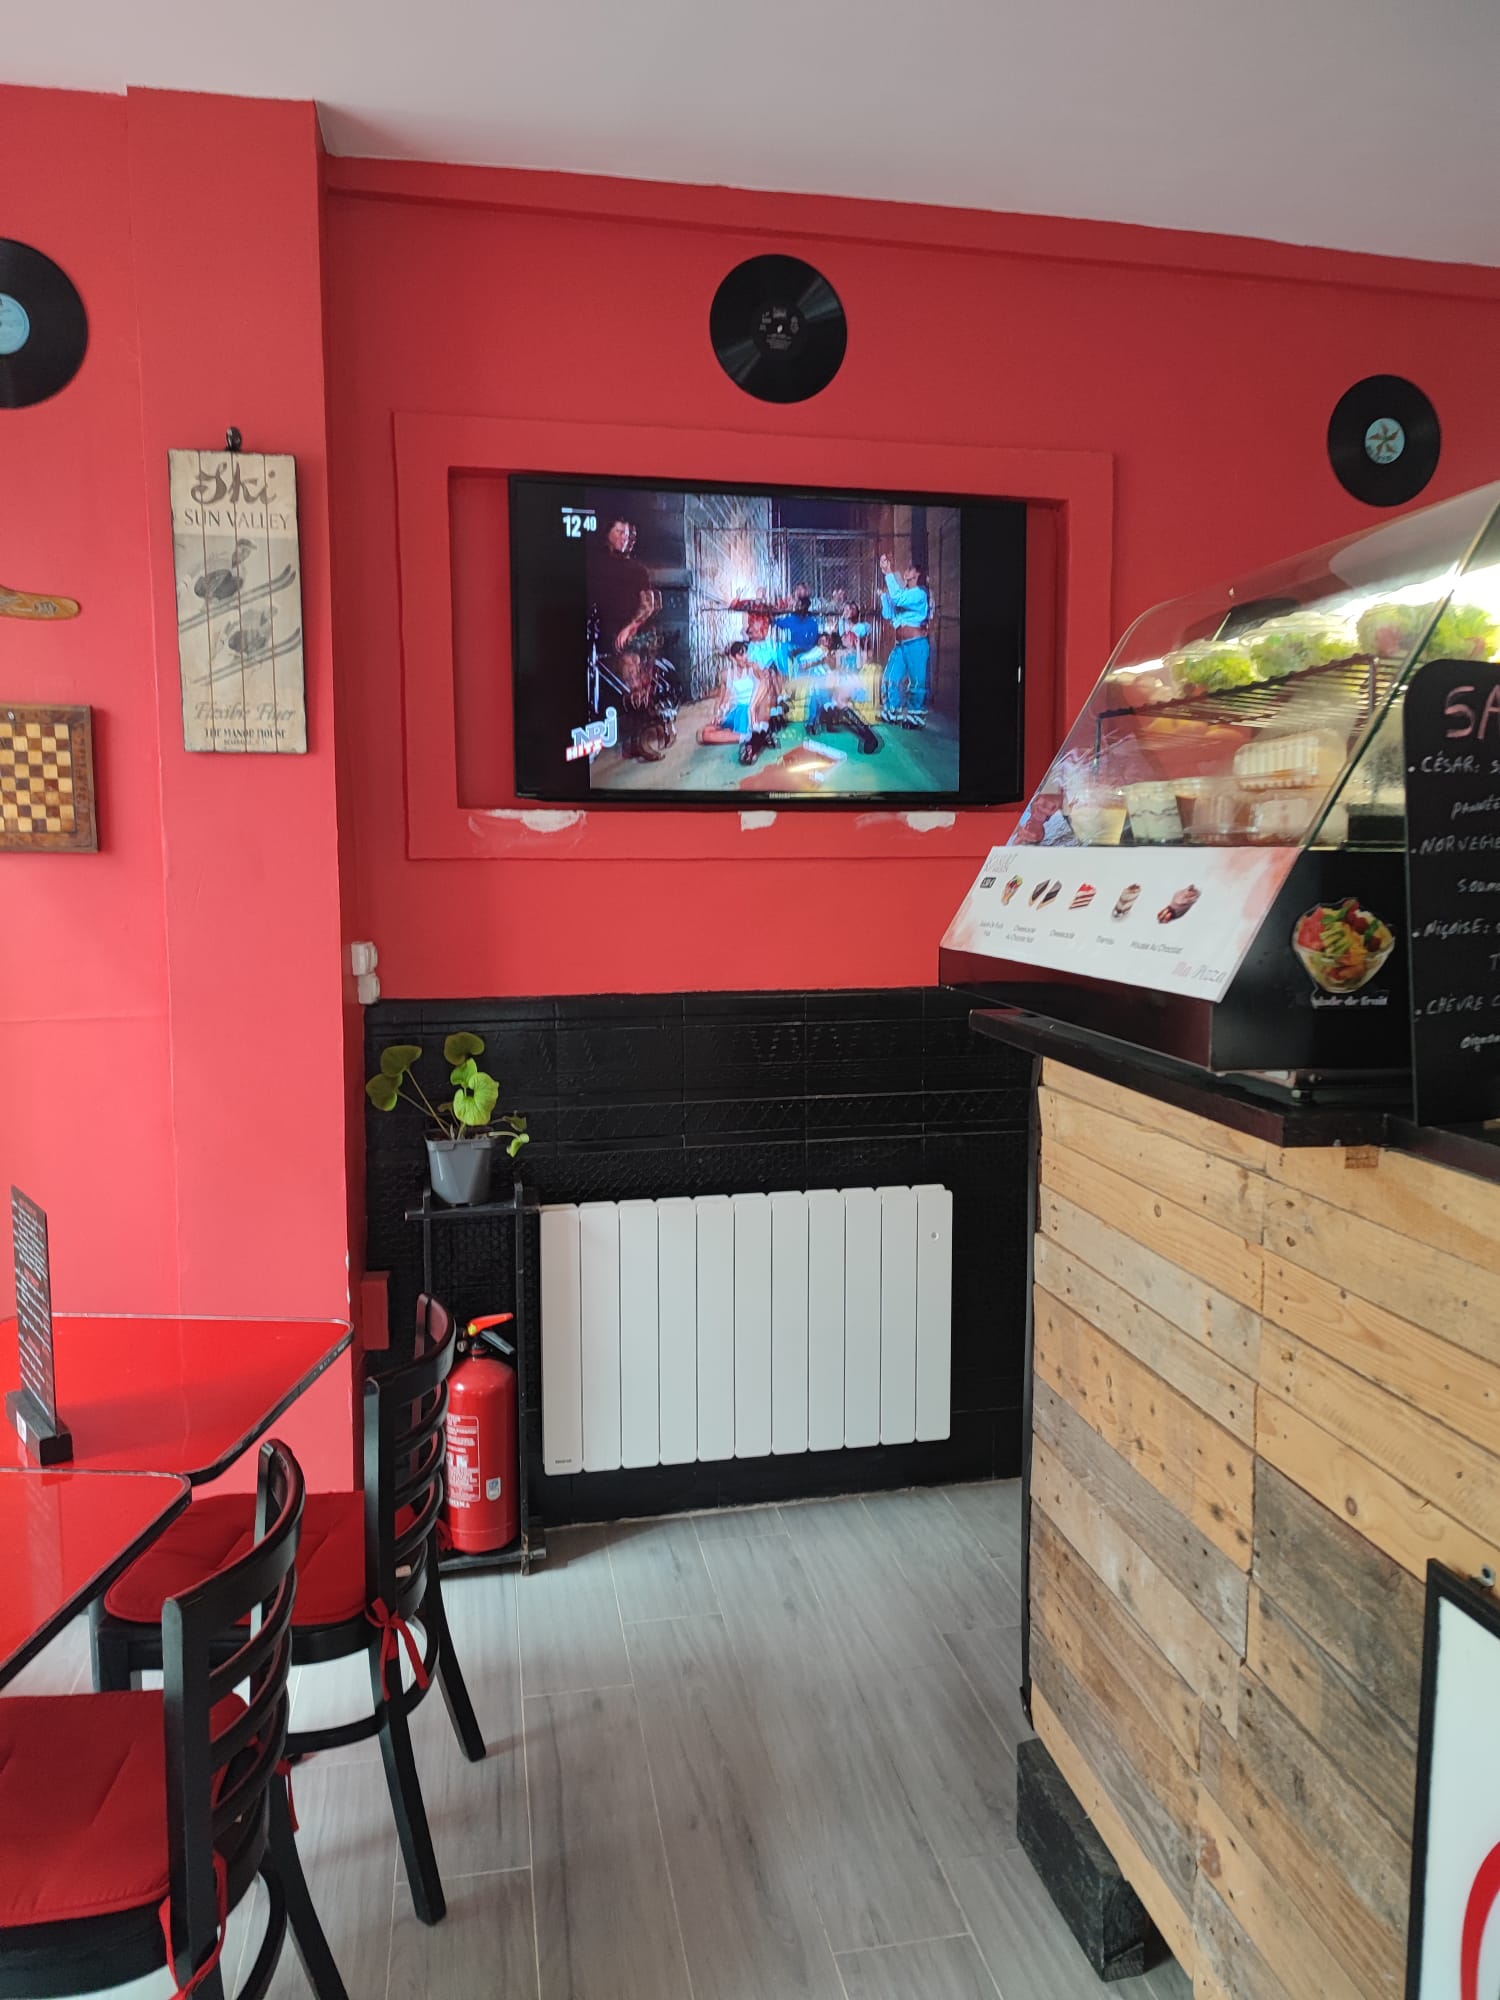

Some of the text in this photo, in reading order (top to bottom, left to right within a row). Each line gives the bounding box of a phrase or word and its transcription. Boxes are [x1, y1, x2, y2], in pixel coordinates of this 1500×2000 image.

[190, 461, 277, 505] Ski
[184, 508, 289, 530] SUN VALLEY
[562, 514, 597, 538] 12 40
